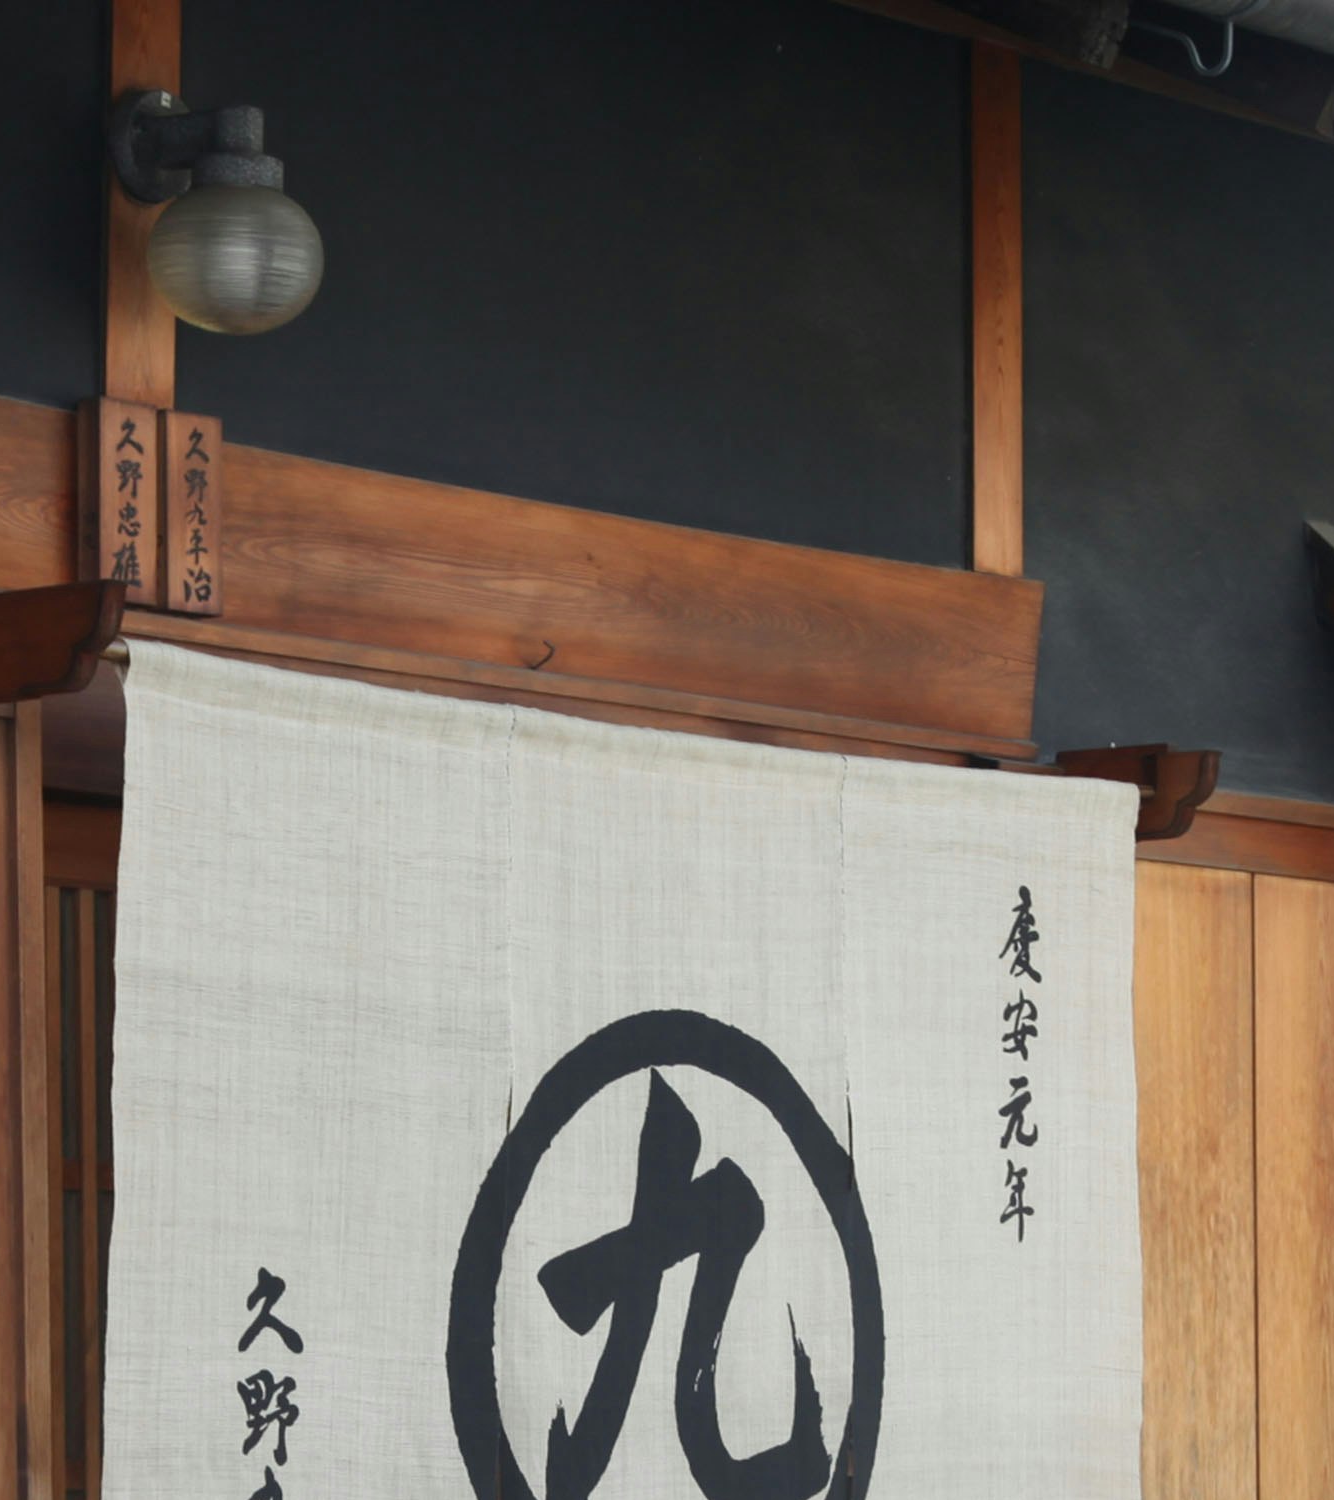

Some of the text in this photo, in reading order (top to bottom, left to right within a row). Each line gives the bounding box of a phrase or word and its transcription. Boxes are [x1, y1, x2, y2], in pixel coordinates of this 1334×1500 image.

[183, 427, 213, 603] 久野九平治
[998, 885, 1043, 1243] 慶安元年
